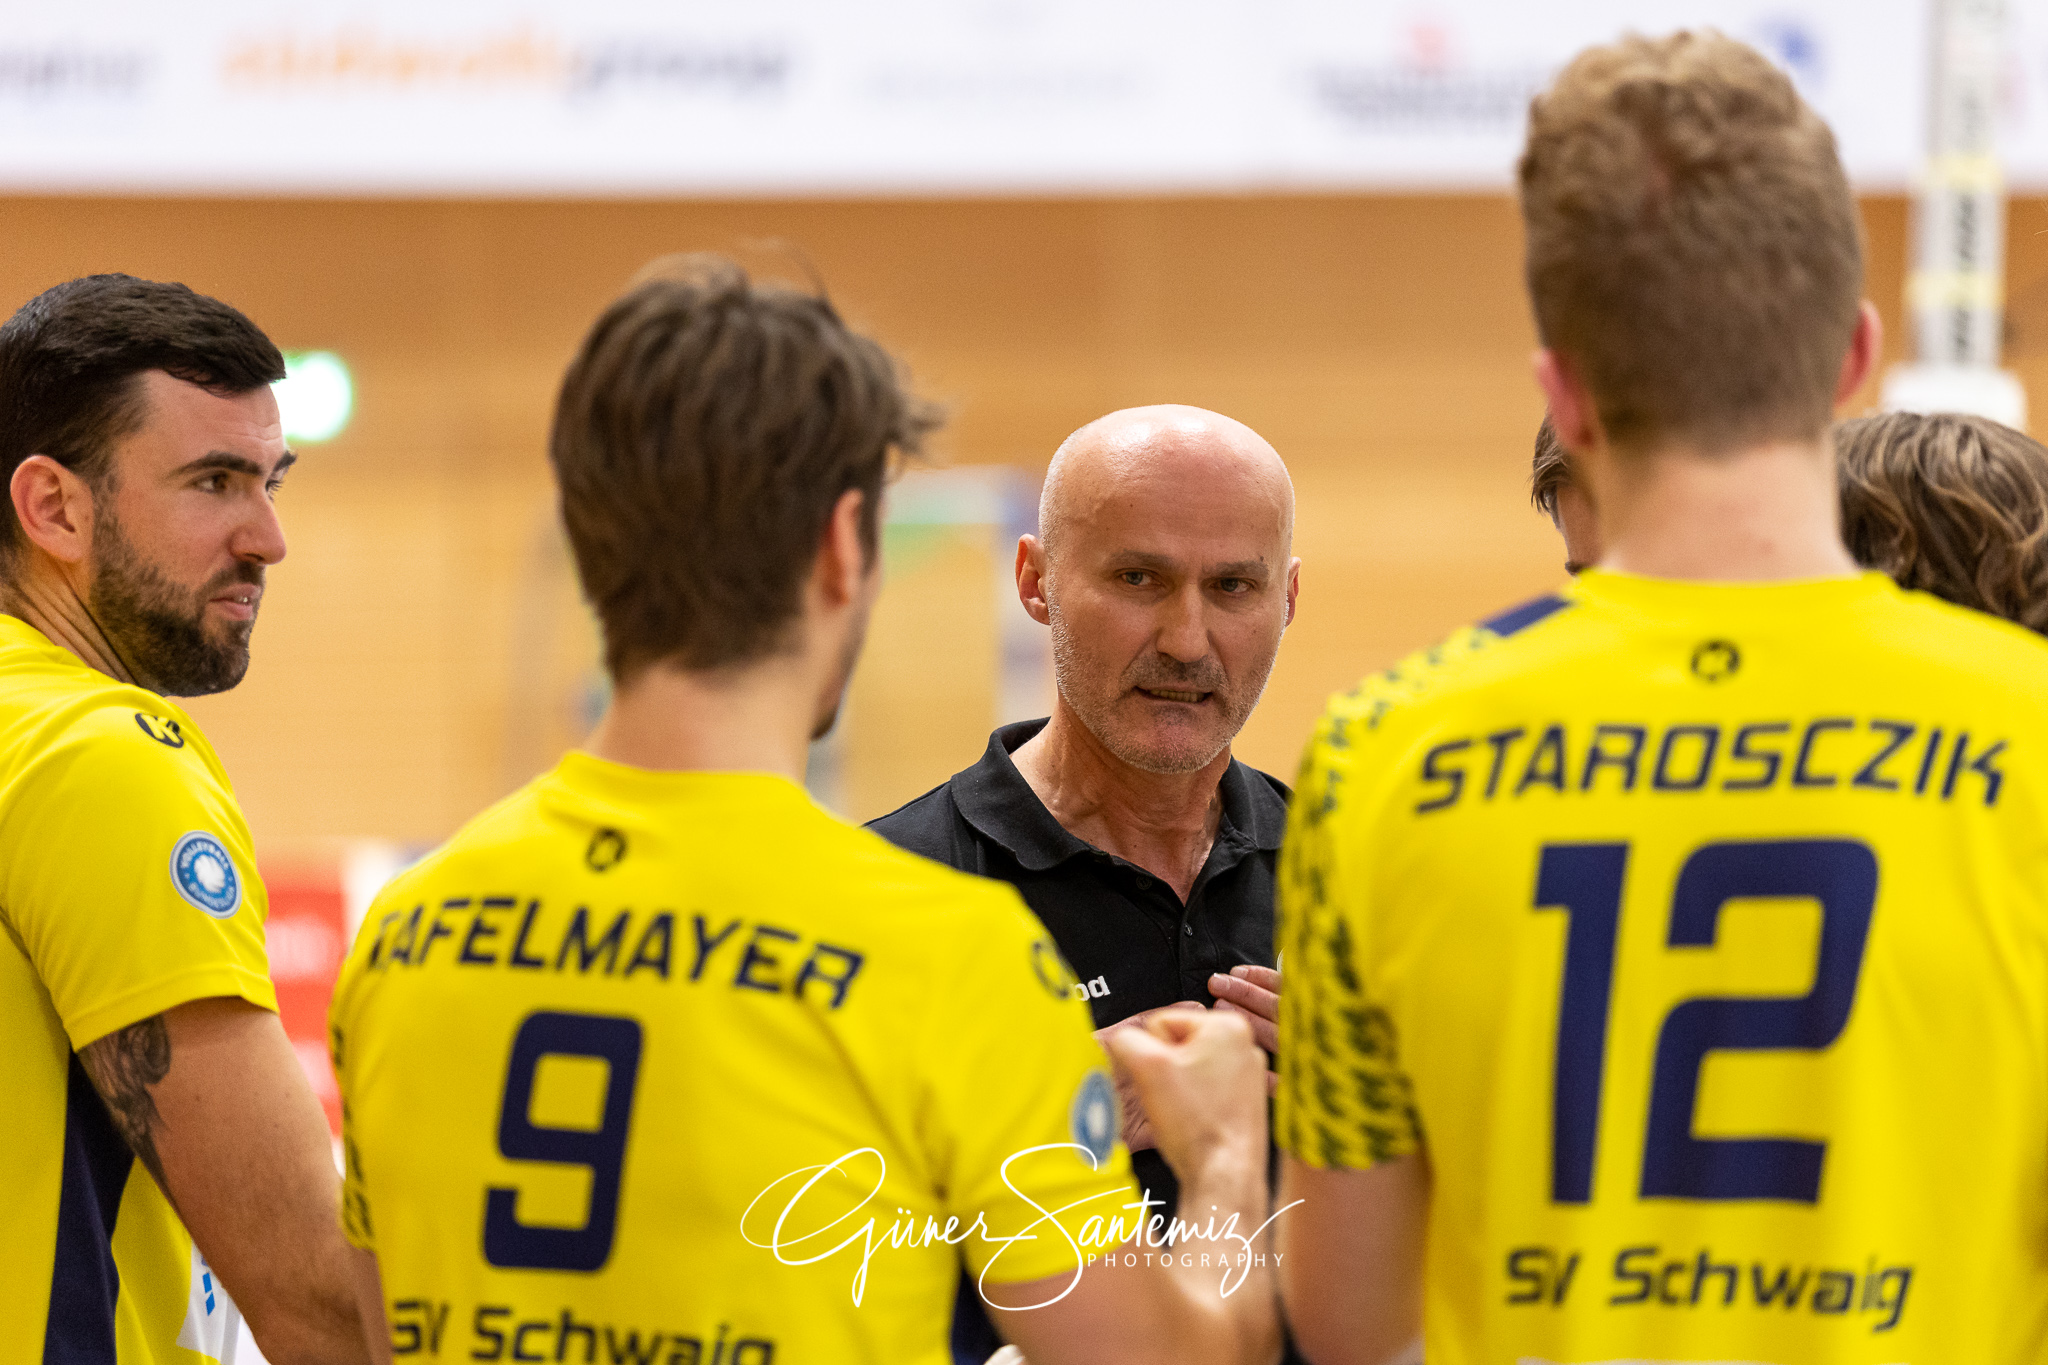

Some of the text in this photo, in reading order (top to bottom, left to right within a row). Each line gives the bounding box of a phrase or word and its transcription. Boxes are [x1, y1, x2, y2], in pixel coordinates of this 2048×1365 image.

[1415, 719, 2006, 815] STAROSCZIK
[366, 896, 866, 1011] TAFELMAYER
[1531, 837, 1881, 1208] 12
[478, 1008, 646, 1277] 9
[391, 1298, 451, 1357] SV
[1505, 1245, 1914, 1334] SV Schwaig
